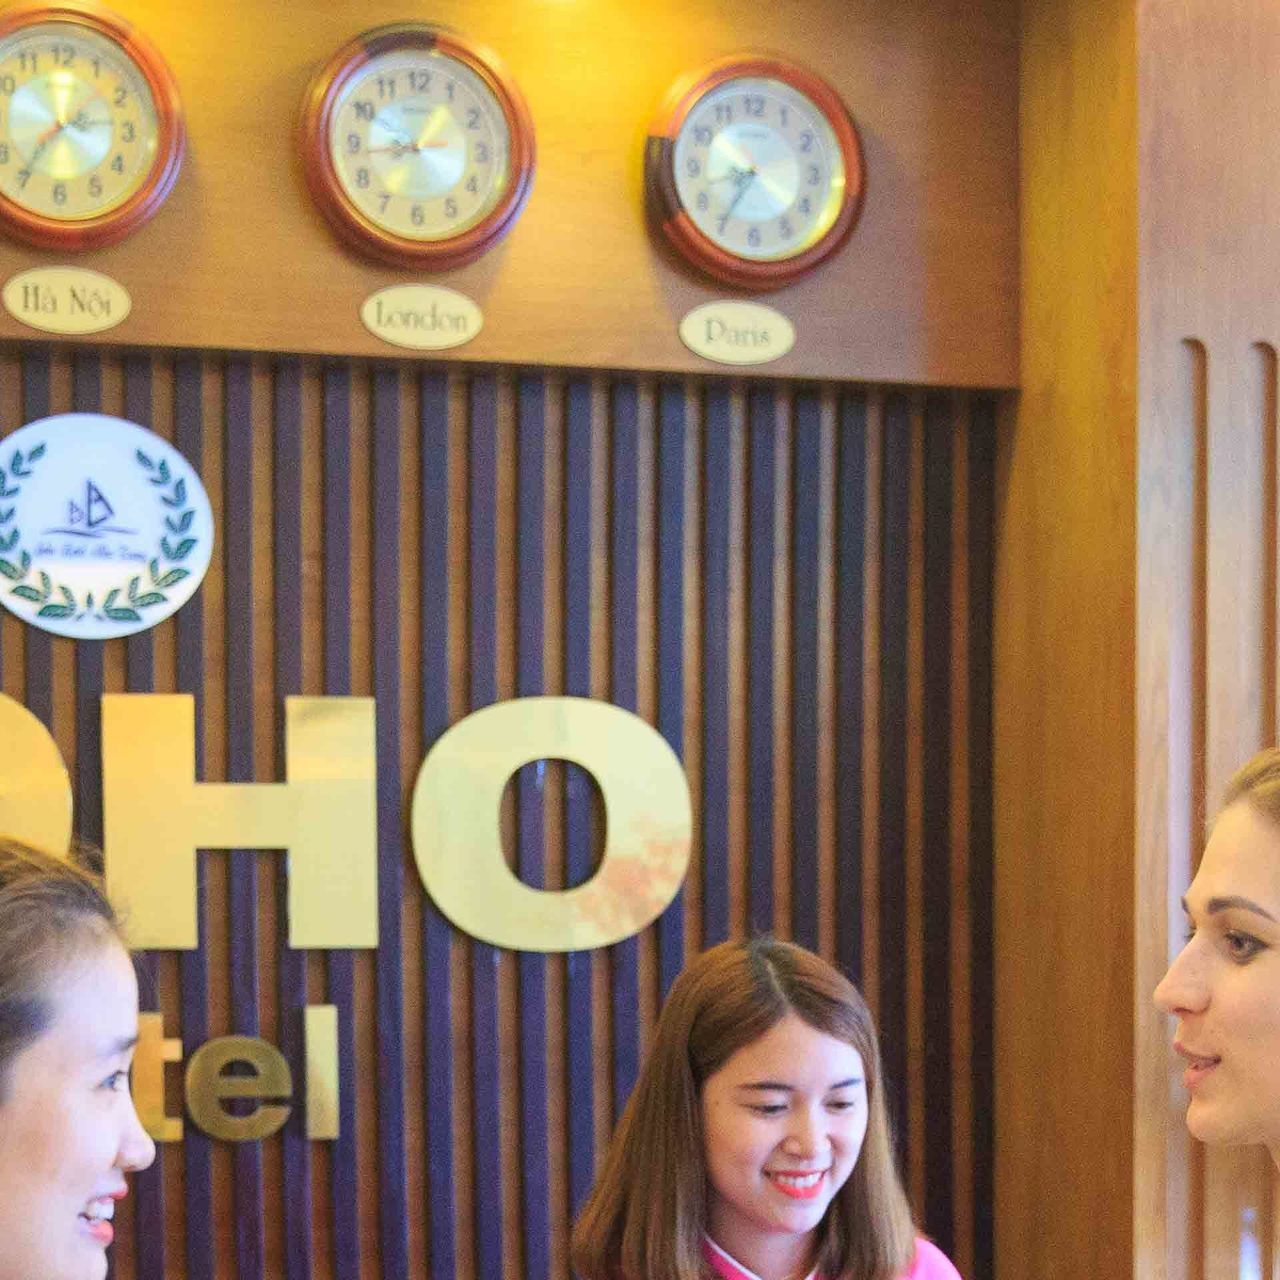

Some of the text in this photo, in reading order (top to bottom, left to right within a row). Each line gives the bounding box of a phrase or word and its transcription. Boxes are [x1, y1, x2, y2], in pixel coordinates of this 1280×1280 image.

[19, 50, 38, 73] 11
[51, 47, 76, 69] 12
[93, 59, 101, 78] 1
[376, 79, 396, 100] 11
[408, 72, 432, 93] 12
[446, 83, 455, 101] 1
[114, 86, 128, 108] 2
[352, 100, 376, 122] 10
[467, 108, 482, 130] 2
[122, 122, 136, 144] 3
[347, 133, 361, 153] 9
[111, 154, 125, 174] 4
[475, 142, 490, 164] 3
[89, 175, 103, 198] 5
[356, 167, 370, 189] 8
[464, 174, 480, 195] 4
[53, 182, 68, 206] 6
[379, 191, 393, 213] 7
[410, 204, 425, 226] 6
[443, 197, 458, 219] 5
[376, 301, 468, 332] London
[704, 318, 770, 347] Paris
[129, 1003, 340, 1143] tel
